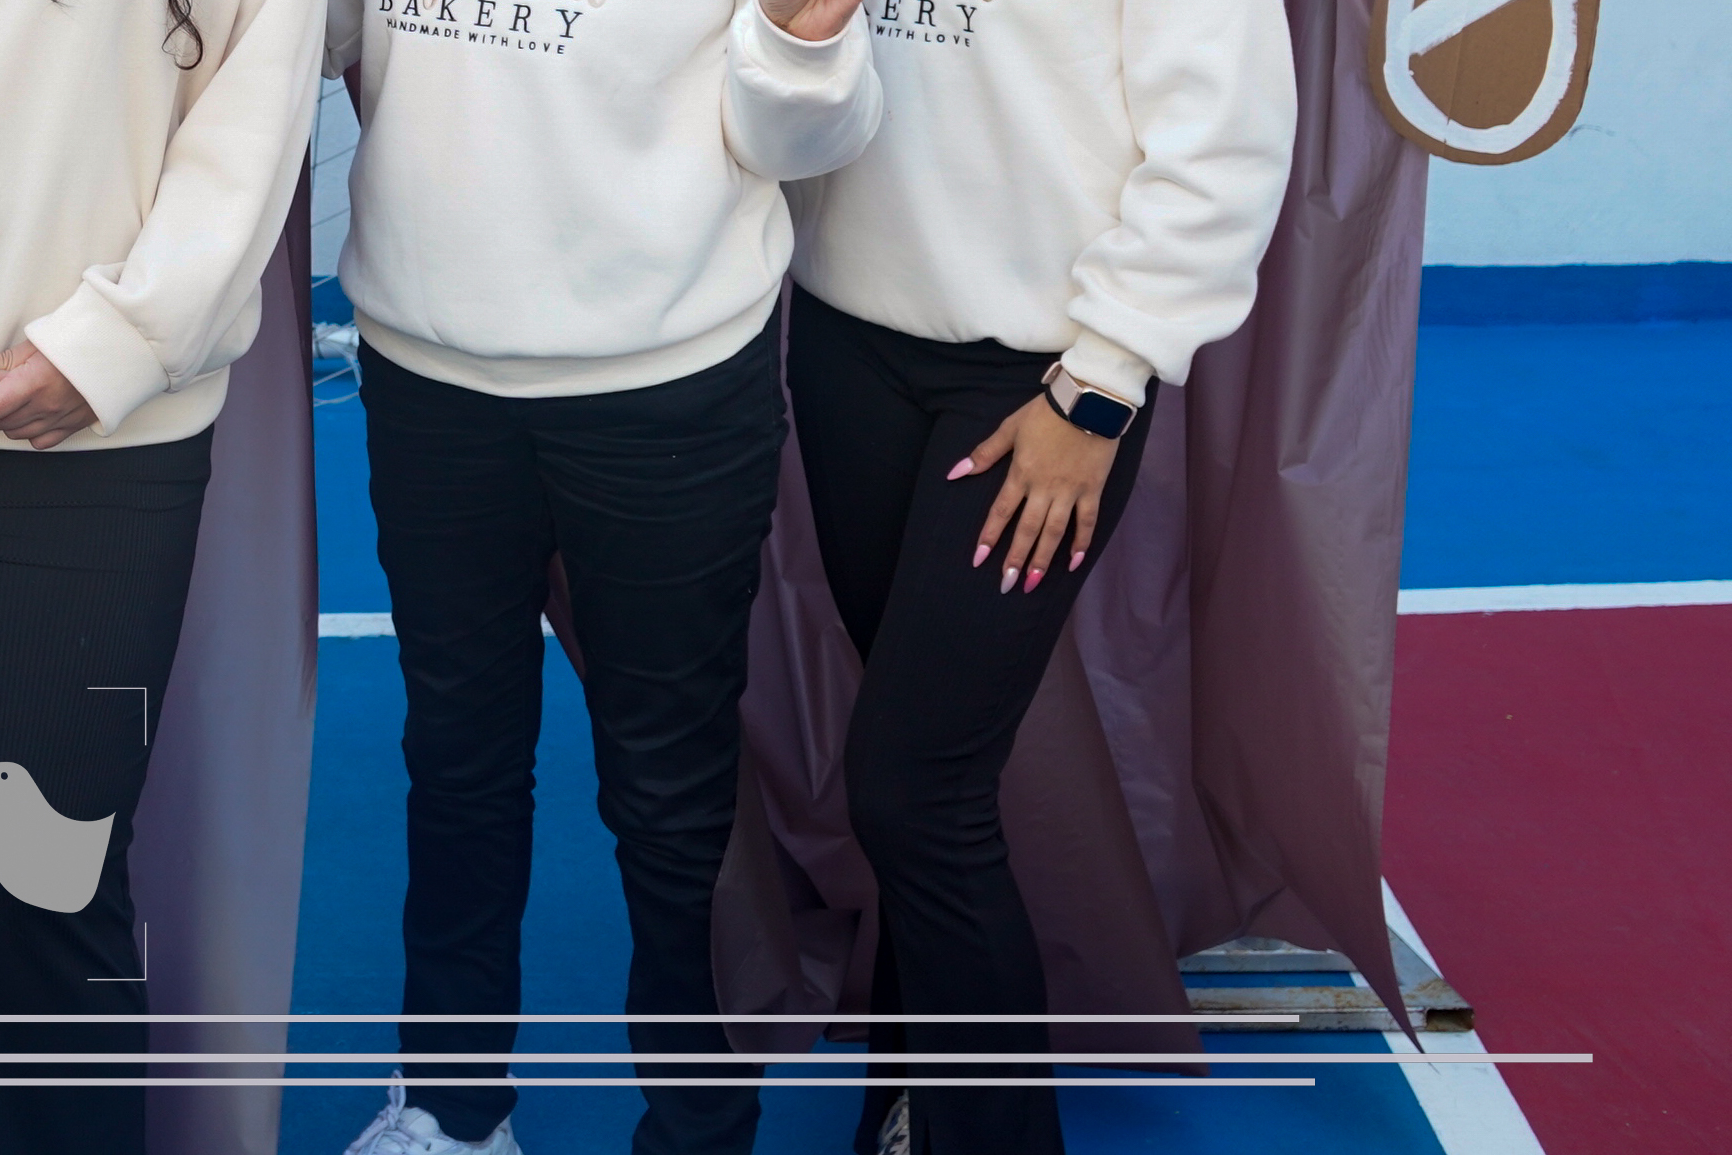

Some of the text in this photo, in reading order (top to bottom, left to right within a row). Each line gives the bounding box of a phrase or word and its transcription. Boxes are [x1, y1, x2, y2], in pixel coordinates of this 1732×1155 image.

[386, 17, 565, 55] HANDMADE WITH LOVE
[875, 26, 971, 48] WITH LOVE
